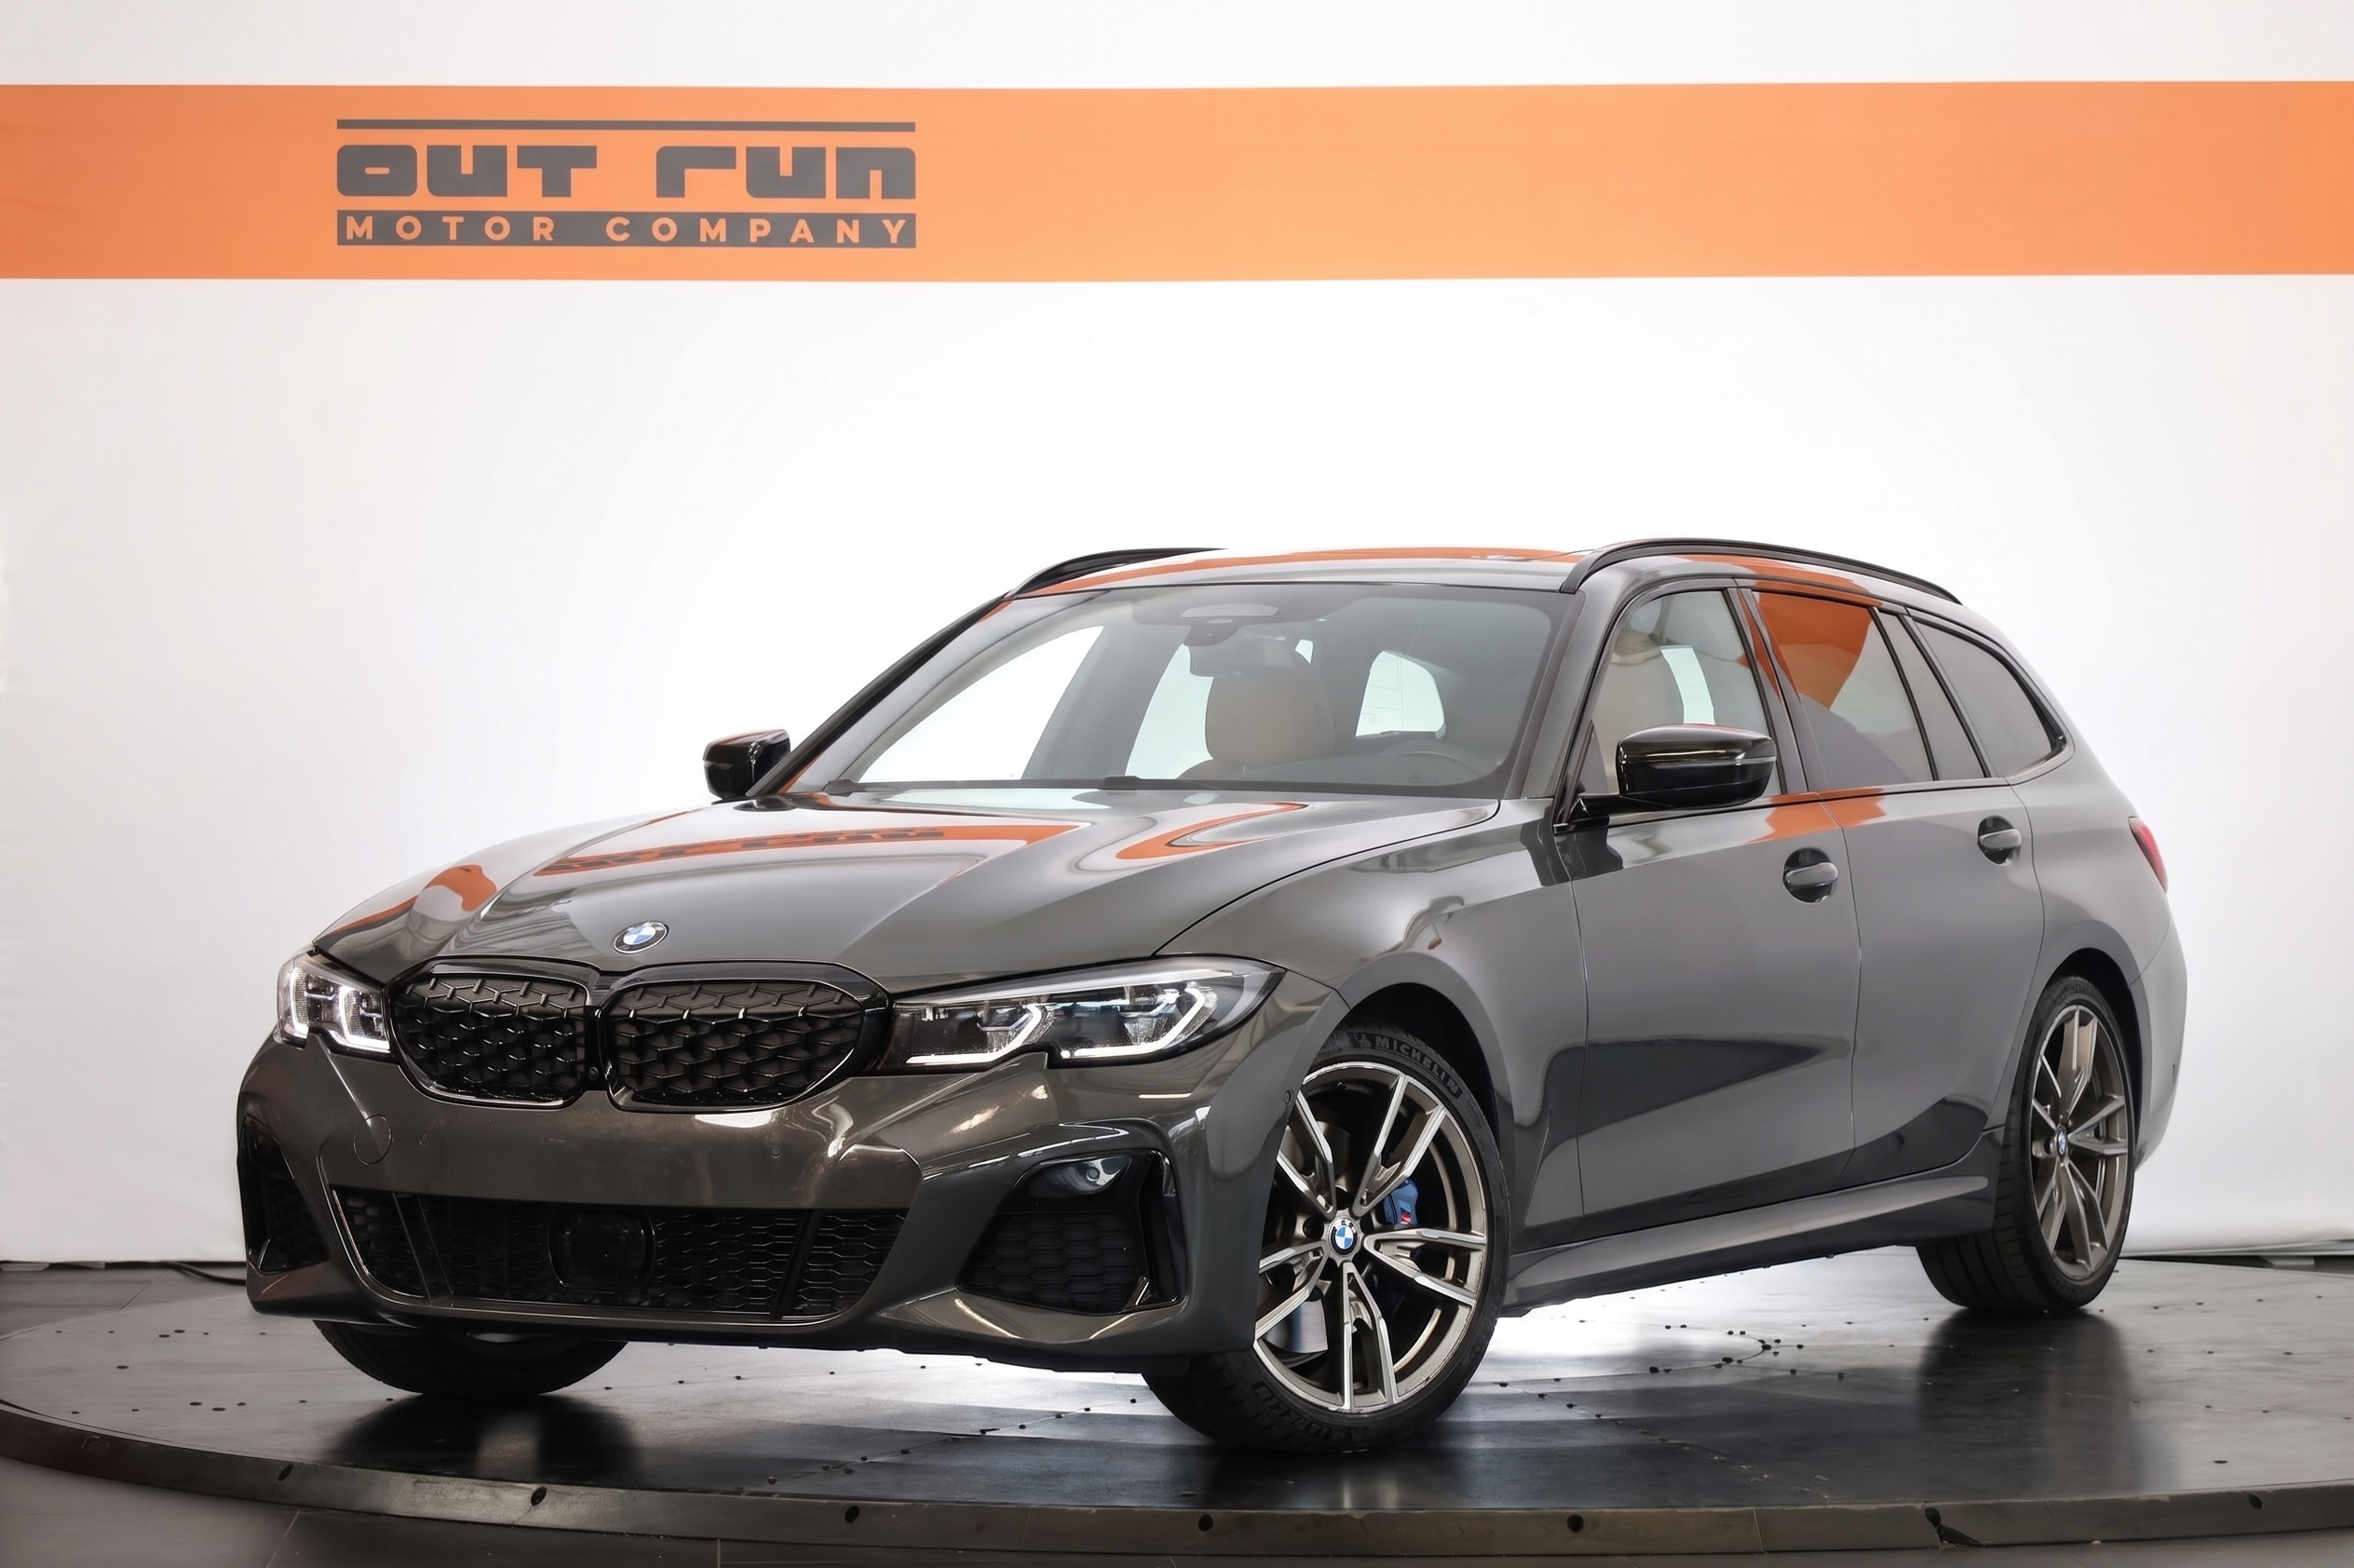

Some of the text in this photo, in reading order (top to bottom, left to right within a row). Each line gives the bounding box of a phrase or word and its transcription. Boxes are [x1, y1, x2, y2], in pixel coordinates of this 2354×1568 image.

[346, 215, 906, 245] MOTOR COMPANY
[1374, 1035, 1460, 1095] MICHELIN
